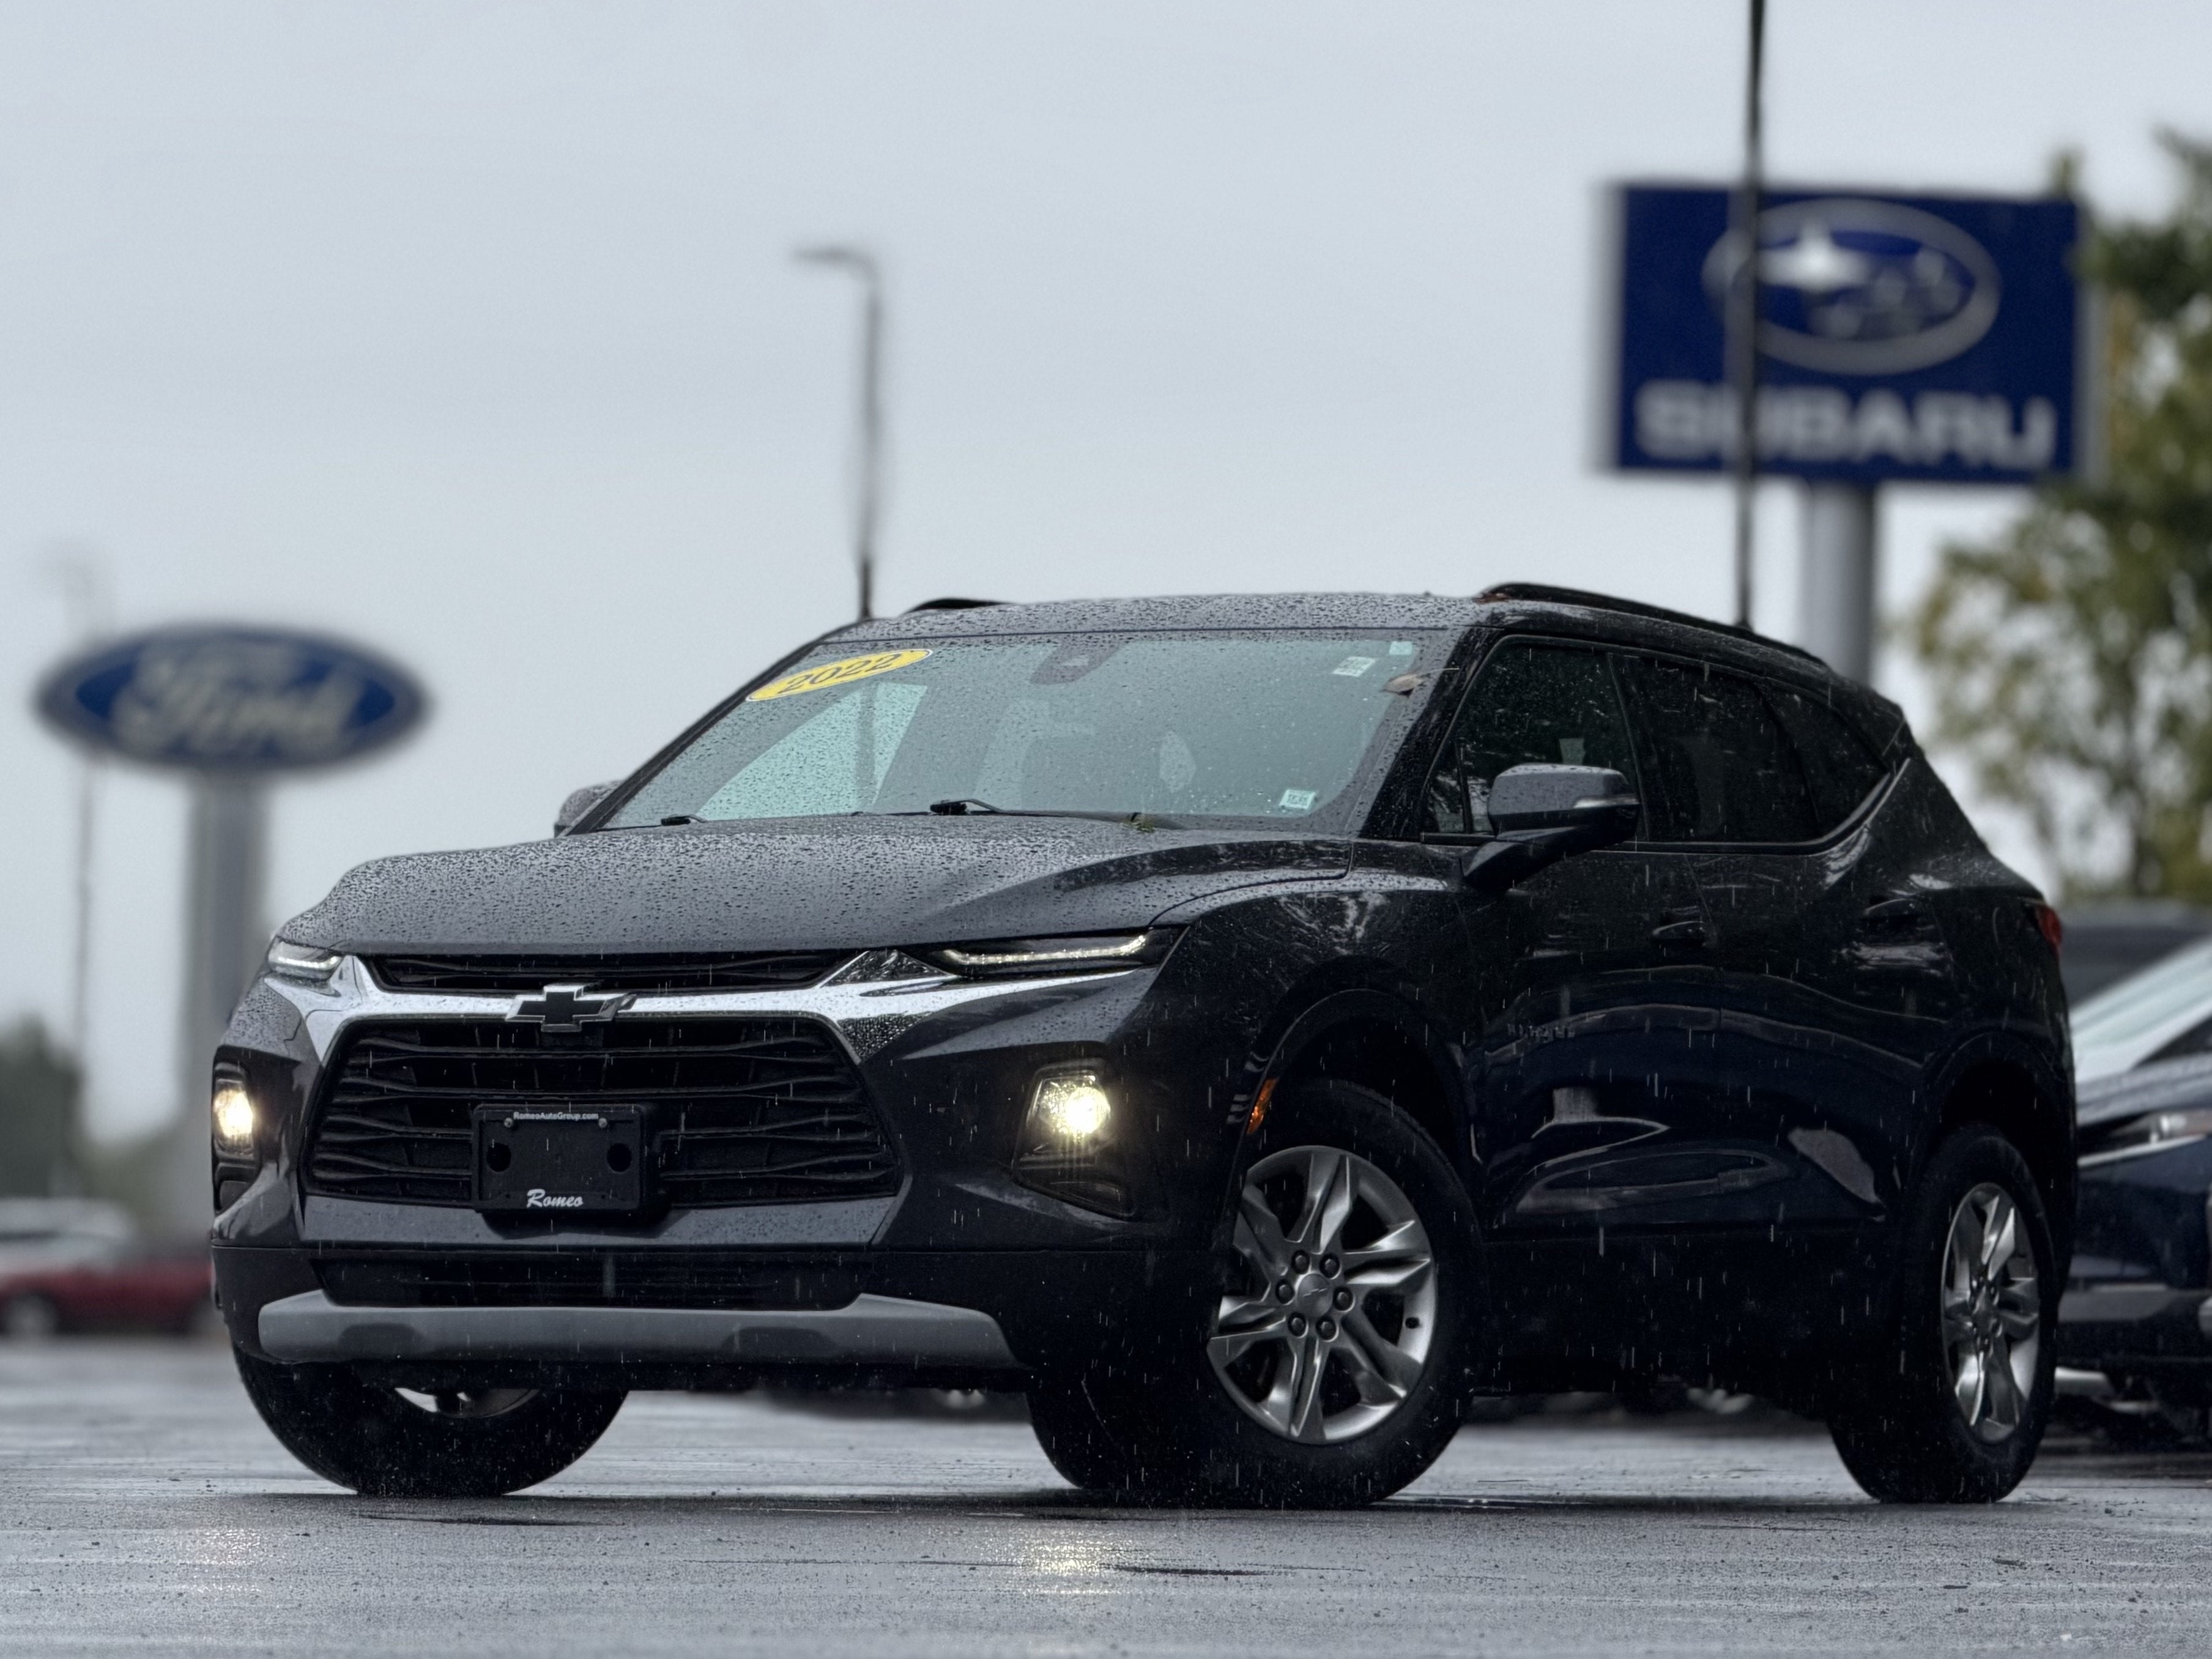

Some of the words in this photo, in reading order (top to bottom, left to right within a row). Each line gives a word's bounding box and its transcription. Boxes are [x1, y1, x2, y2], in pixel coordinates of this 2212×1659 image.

[1633, 380, 2058, 471] SUBARU
[777, 652, 903, 695] 2022
[111, 639, 363, 756] Ford
[513, 1111, 599, 1121] RomeoAutoGroup.com
[526, 1188, 584, 1208] Romeo
